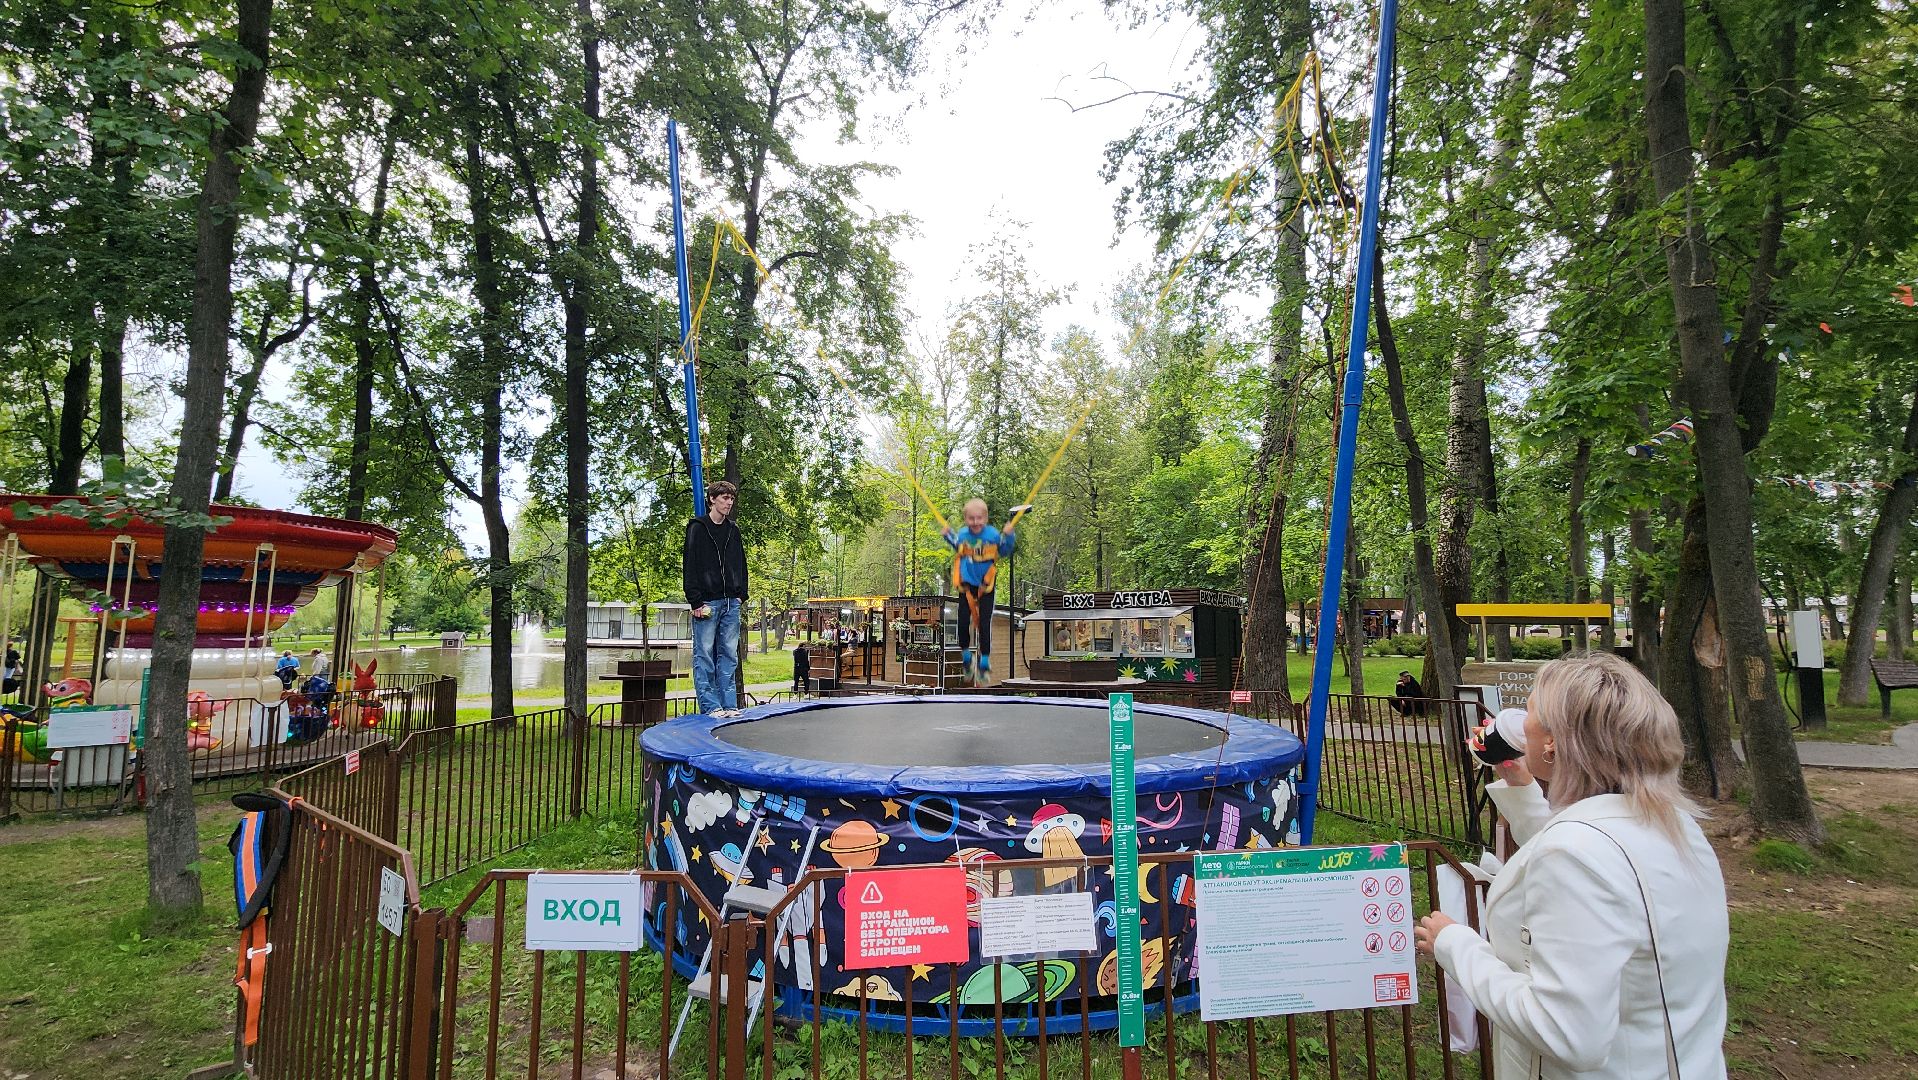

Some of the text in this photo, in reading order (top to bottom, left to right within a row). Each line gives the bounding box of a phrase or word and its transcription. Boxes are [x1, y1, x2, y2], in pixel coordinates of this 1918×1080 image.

[1063, 590, 1173, 608] ВКУС ДЕТСТВА
[1499, 672, 1536, 680] ГОРЯ
[1496, 683, 1533, 692] КУКУ
[1501, 695, 1528, 705] СЛА
[543, 899, 622, 926] ВХОД
[861, 909, 909, 920] ВХОД НА
[861, 917, 935, 929] АТТРАКЦИОН
[861, 925, 949, 938] БЕЗ ОПЕРАТОРА
[861, 937, 906, 948] СТРОГО
[861, 945, 921, 957] ЗАПРЕЩЕН
[1397, 988, 1410, 997] 112
